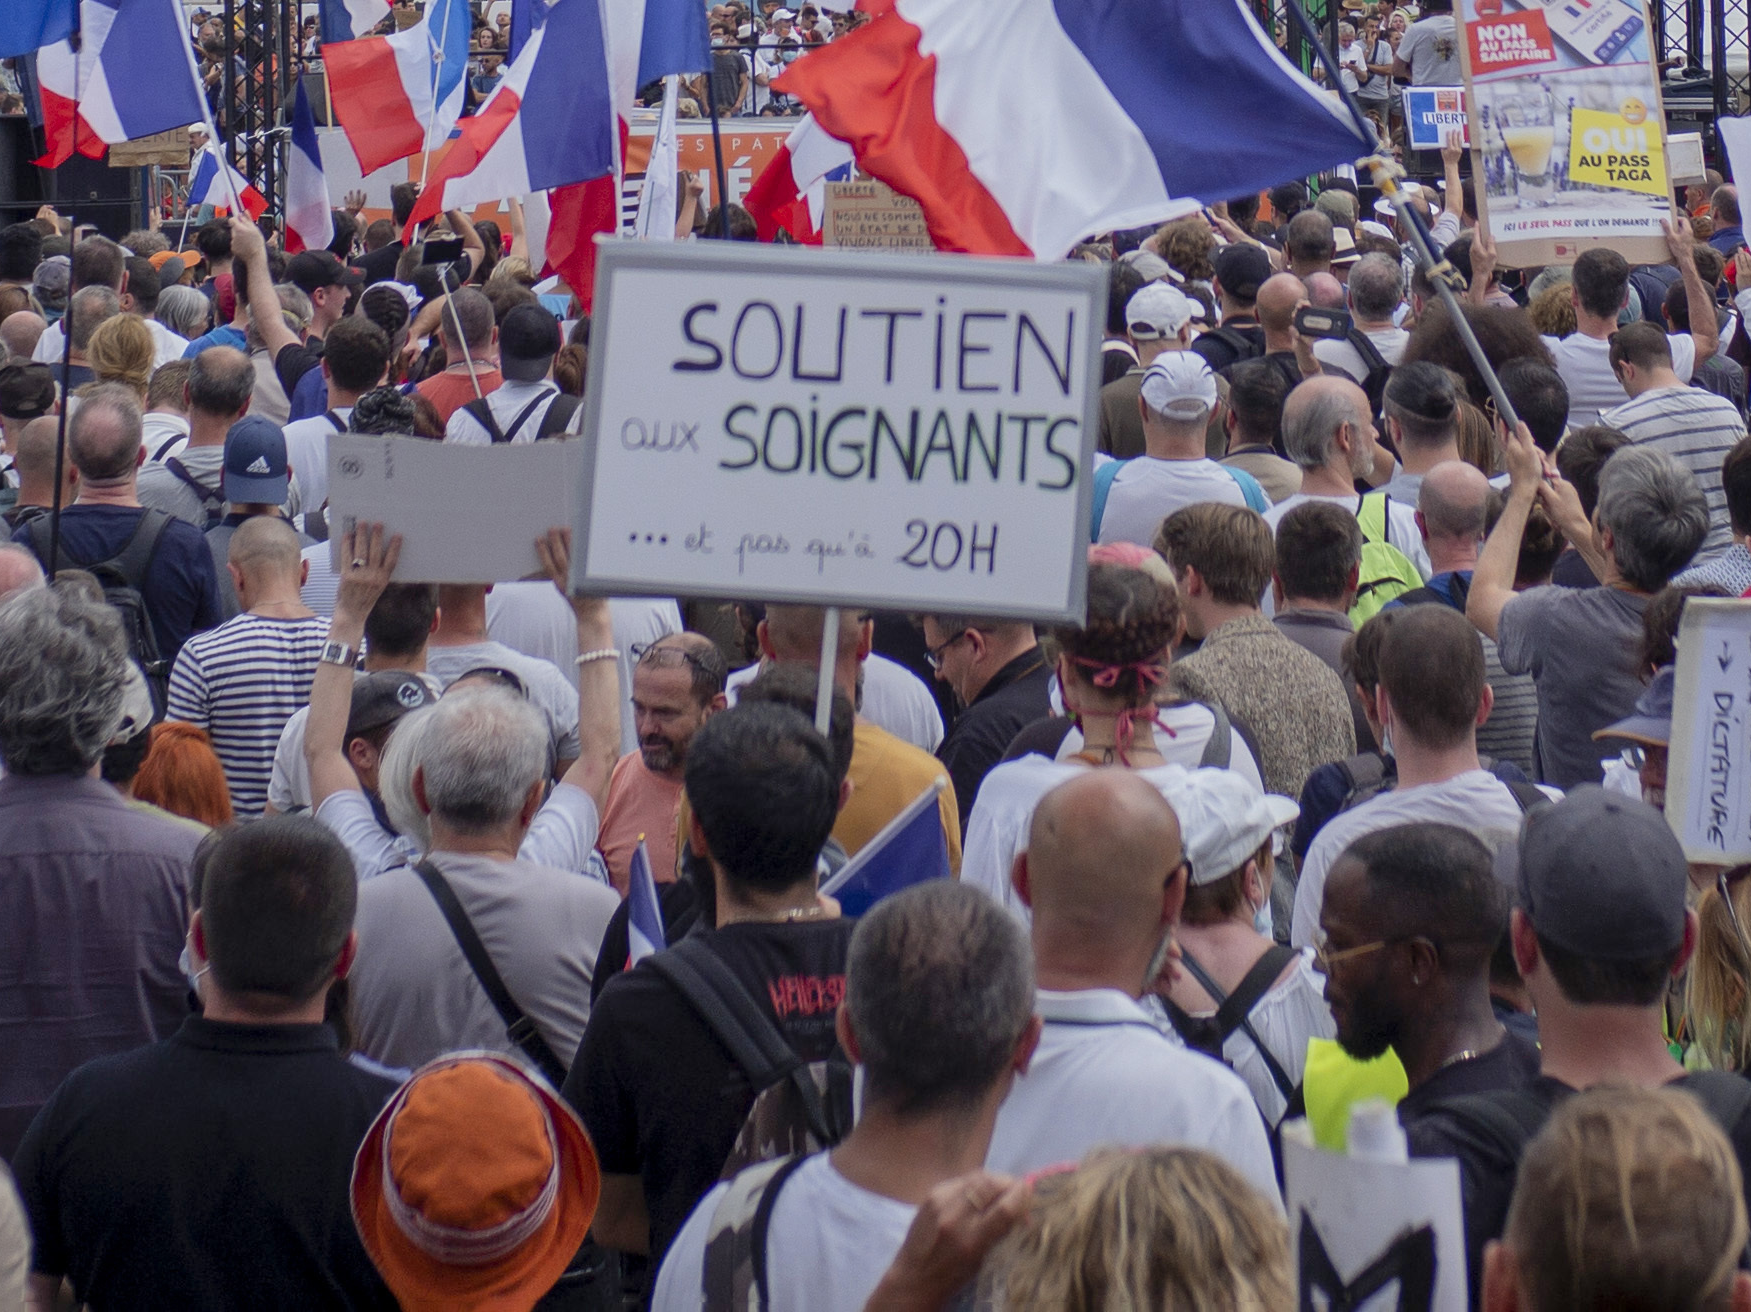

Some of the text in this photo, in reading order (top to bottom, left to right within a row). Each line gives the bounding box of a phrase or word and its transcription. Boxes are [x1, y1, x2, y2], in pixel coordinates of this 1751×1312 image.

[1477, 23, 1528, 42] NON
[1479, 38, 1537, 52] AU PASS
[1480, 49, 1552, 64] SANITAIRE
[1582, 127, 1648, 155] OUI
[1579, 155, 1650, 167] AU PASS
[1605, 169, 1652, 181] TAGA
[1503, 223, 1516, 231] ICI
[1518, 222, 1527, 230] LE
[1530, 221, 1550, 229] SEUL
[1574, 219, 1590, 227] QUE
[1592, 218, 1610, 227] L'ON
[1612, 218, 1650, 226] DEMANDE
[620, 417, 702, 453] aux
[684, 521, 715, 552] et
[735, 532, 791, 575] pas
[897, 519, 1000, 575] 20H
